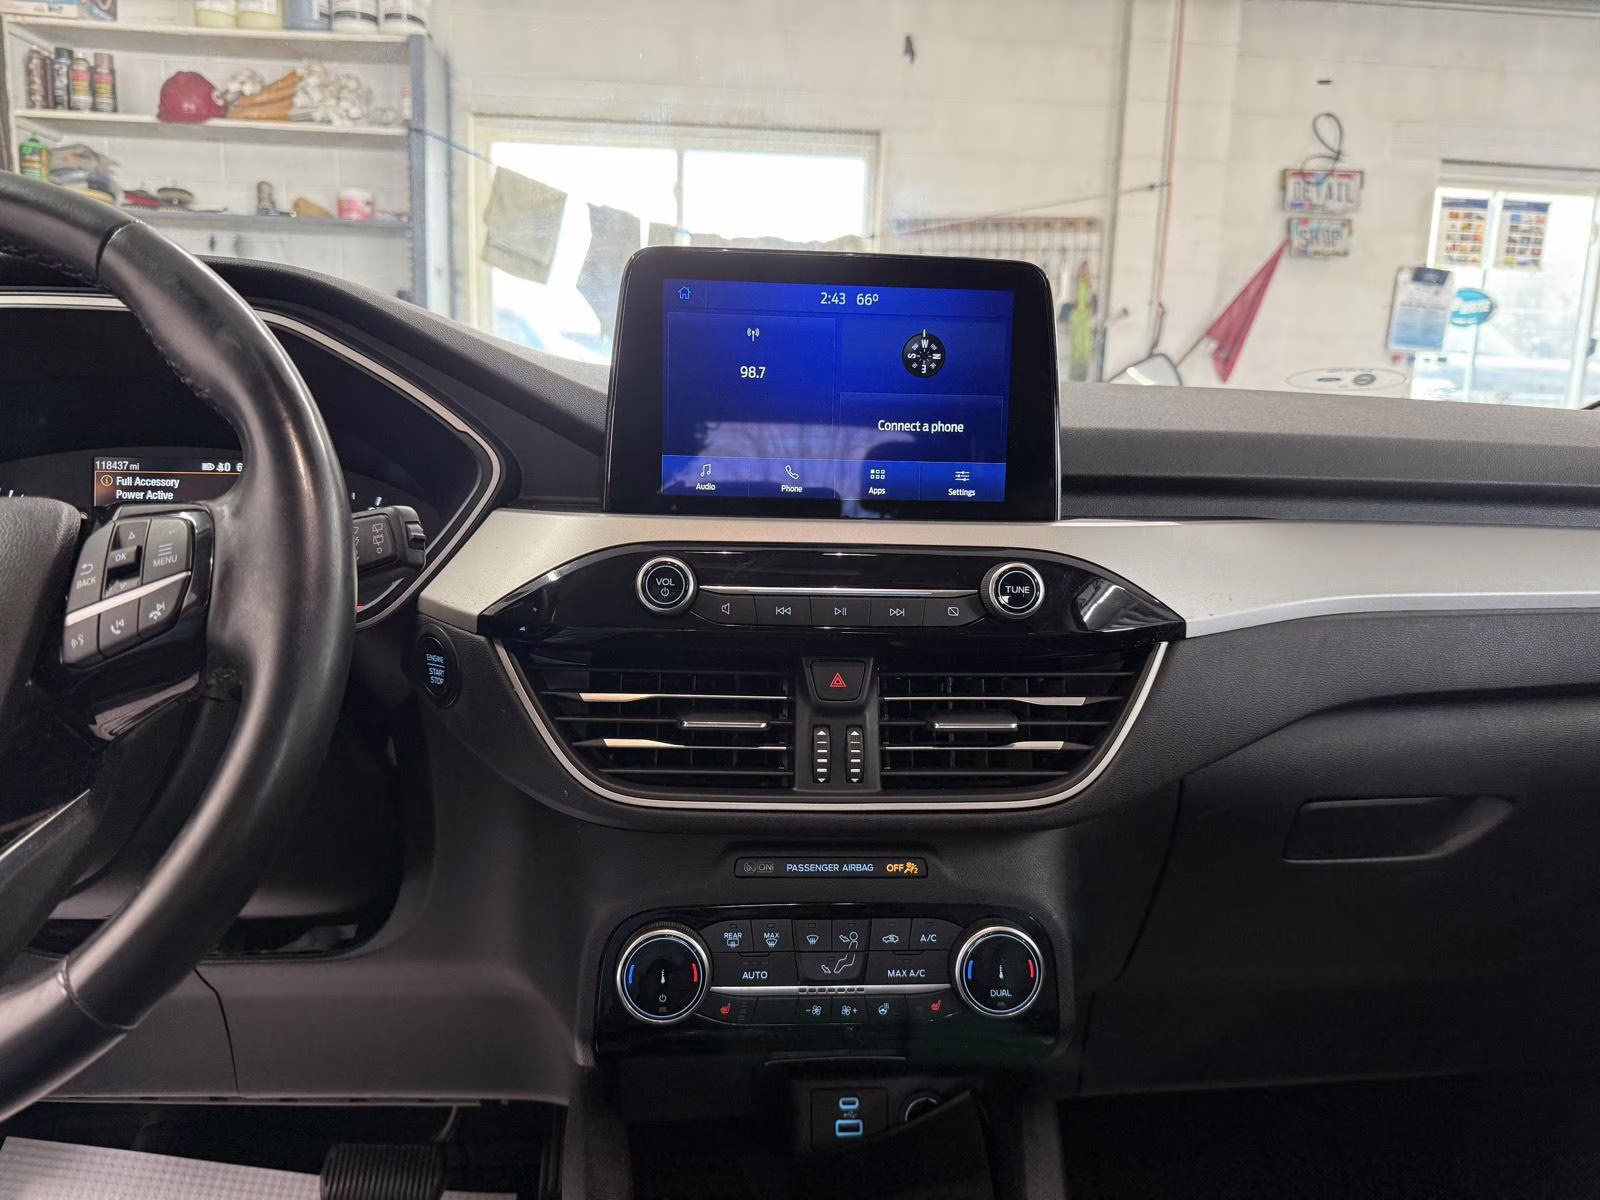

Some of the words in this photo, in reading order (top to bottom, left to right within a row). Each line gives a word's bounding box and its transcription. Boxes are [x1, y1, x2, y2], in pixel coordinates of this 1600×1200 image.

[820, 292, 846, 305] 2:43
[921, 339, 929, 349] W
[740, 366, 766, 379] 98.7
[877, 420, 921, 432] Connect
[922, 423, 930, 431] a
[931, 421, 965, 433] phone
[95, 460, 128, 471] 118437
[129, 461, 140, 471] mi
[116, 476, 133, 487] Full
[134, 477, 180, 489] Accessory
[695, 482, 716, 491] Audio
[781, 484, 803, 494] Phone
[868, 486, 886, 496] Apps
[948, 488, 976, 498] Settings
[116, 489, 145, 500] Power
[146, 490, 174, 501] Active
[115, 552, 127, 562] OK
[152, 554, 178, 568] MENU
[76, 577, 97, 589] BACK
[655, 577, 676, 587] VOL
[1004, 585, 1031, 594] TUNE
[426, 654, 444, 663] ENGINE
[429, 668, 445, 677] START
[430, 676, 445, 684] STOP
[786, 863, 839, 872] PASSENGER
[842, 863, 874, 872] AIRBAG
[886, 863, 904, 872] OFF
[920, 934, 937, 942] A/C
[742, 971, 768, 980] AUTO
[887, 969, 907, 978] MAX
[909, 969, 926, 977] A/C
[990, 989, 1013, 997] DUAL
